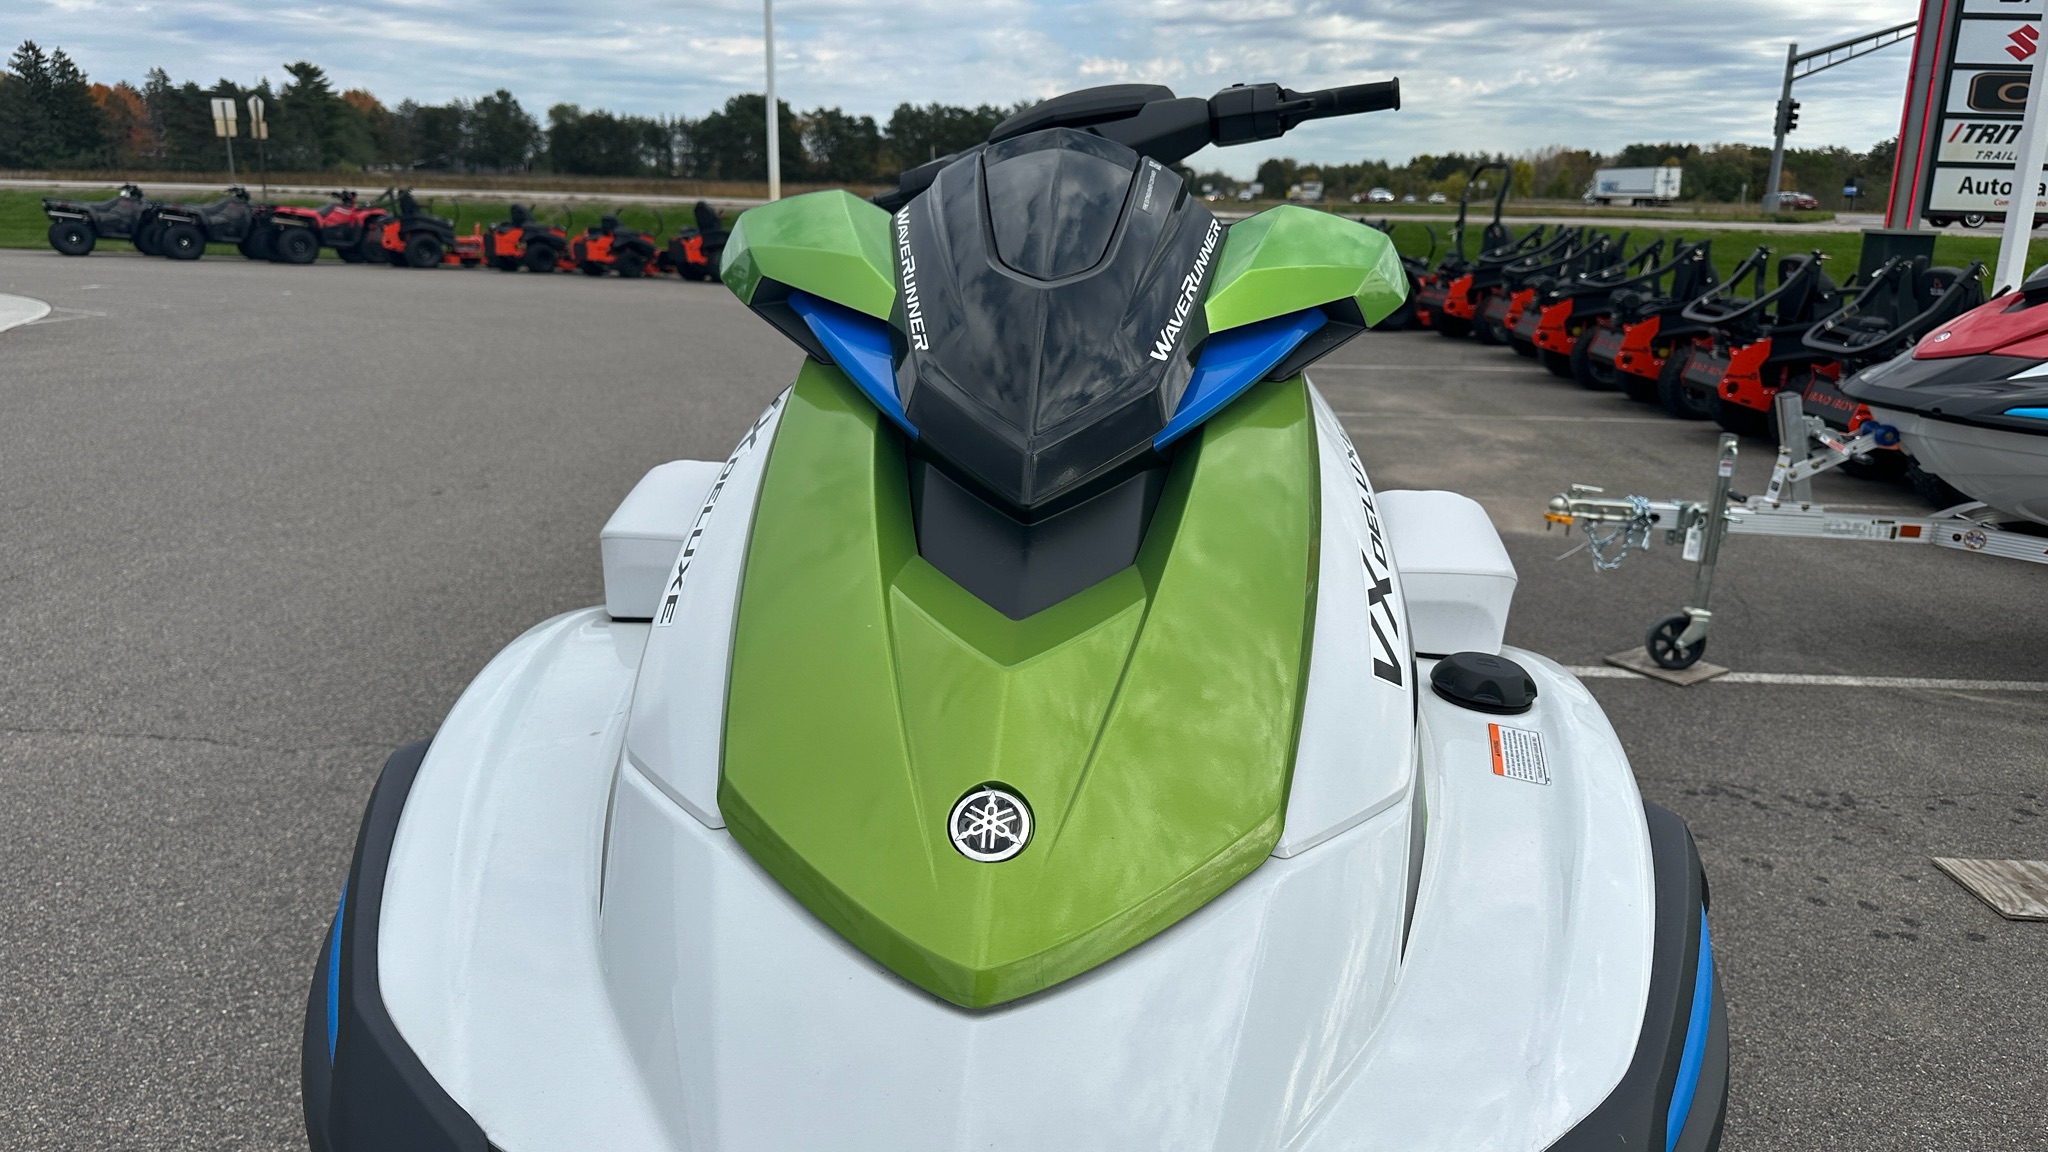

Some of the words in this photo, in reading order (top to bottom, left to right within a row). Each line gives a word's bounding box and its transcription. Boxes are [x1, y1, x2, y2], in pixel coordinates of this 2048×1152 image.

[1961, 124, 2023, 144] TRIT
[1975, 151, 2018, 161] TRAIL
[660, 456, 739, 625] DELUXE
[1360, 547, 1403, 688] VX
